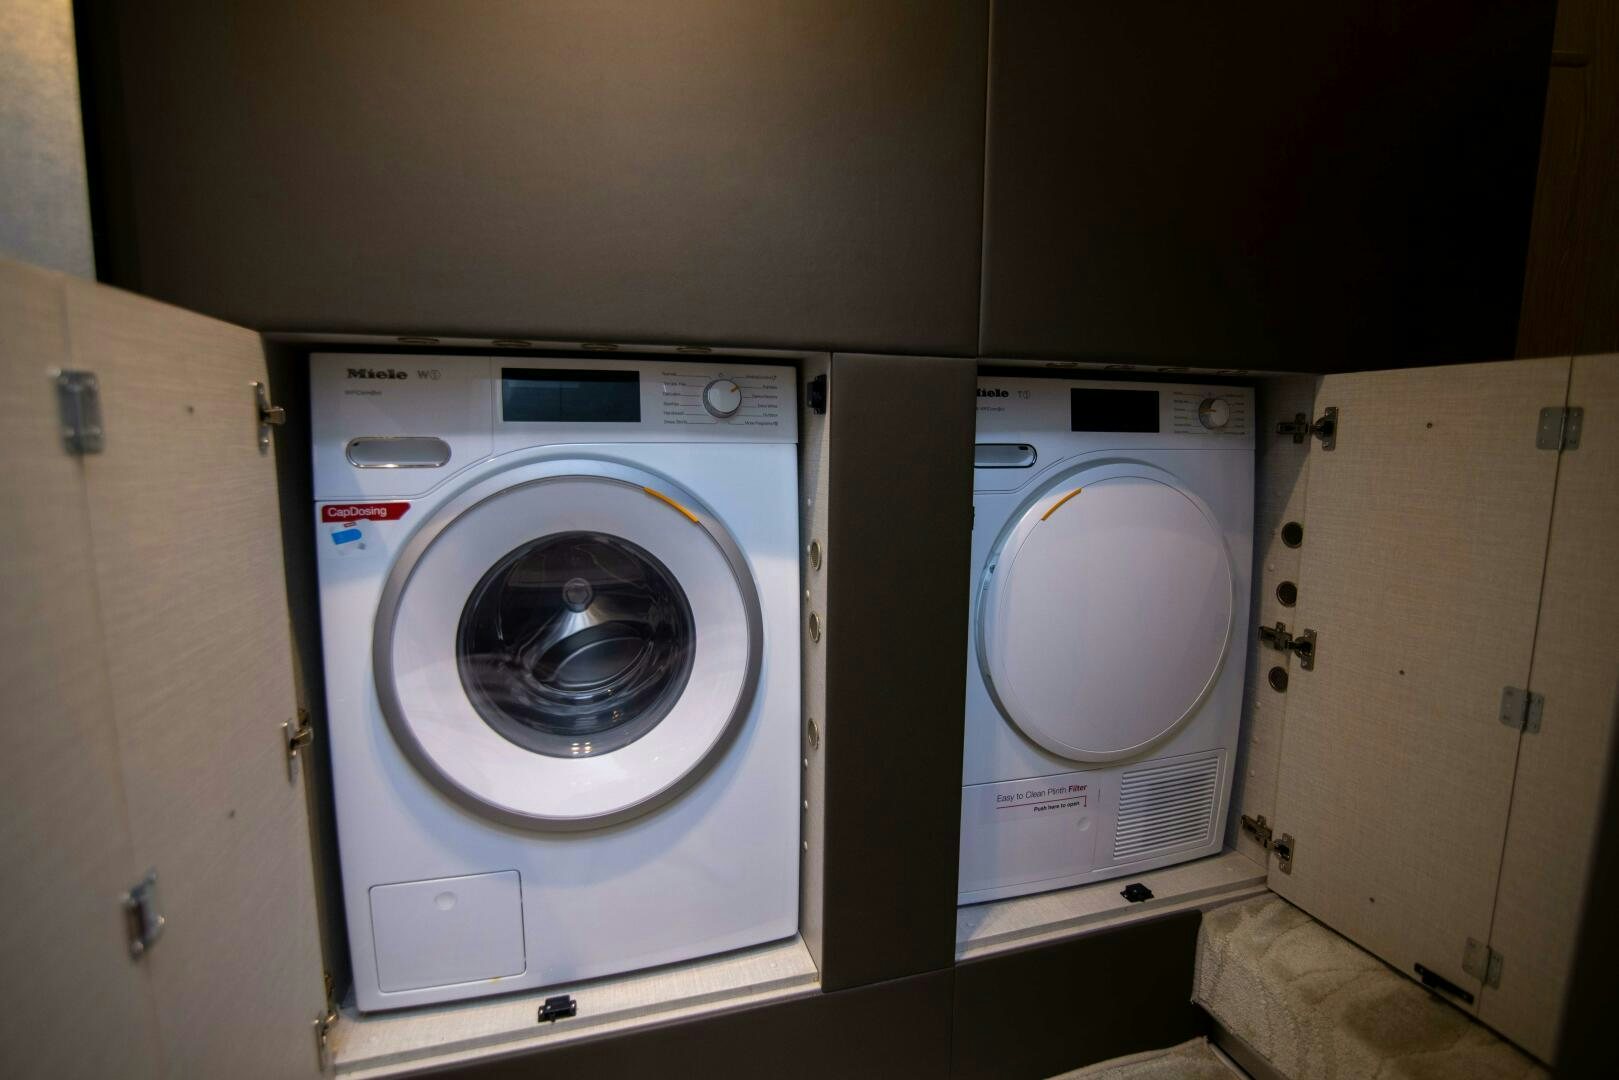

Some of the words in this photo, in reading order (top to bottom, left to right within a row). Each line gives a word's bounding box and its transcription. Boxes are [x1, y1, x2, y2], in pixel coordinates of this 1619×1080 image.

[347, 368, 408, 380] Miele
[328, 507, 387, 517] CapDosing
[997, 794, 1014, 803] Easy
[1025, 790, 1045, 798] Clean
[1047, 786, 1067, 795] Plinth
[1068, 784, 1087, 792] Filter
